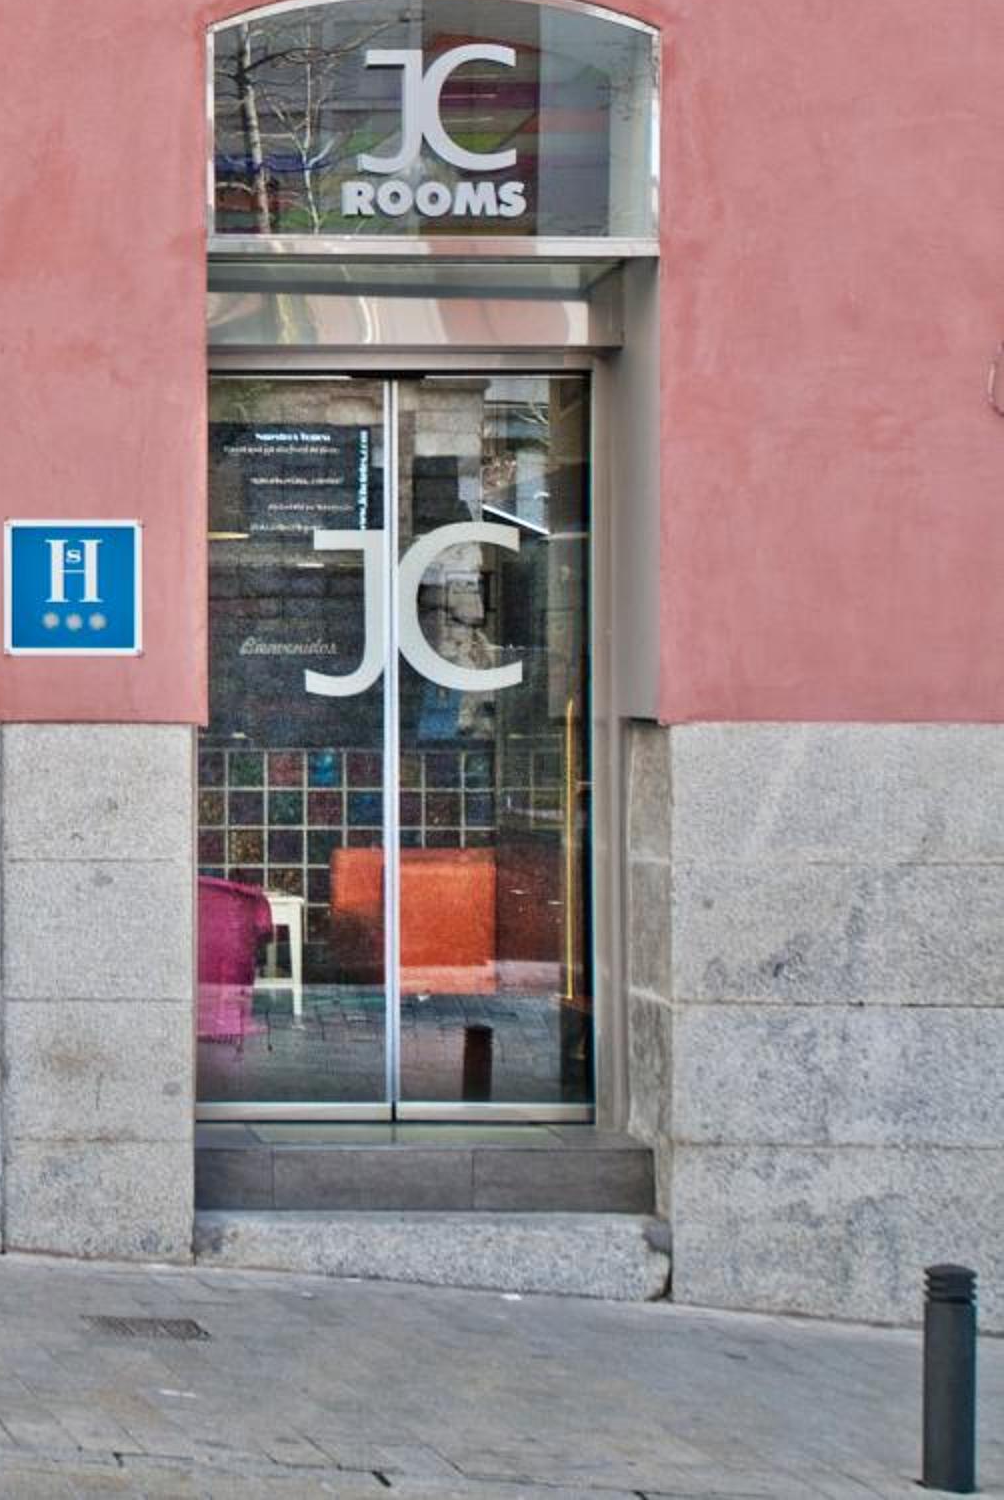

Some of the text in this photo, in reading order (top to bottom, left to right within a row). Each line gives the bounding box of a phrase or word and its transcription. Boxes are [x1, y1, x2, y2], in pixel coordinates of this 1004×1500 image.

[358, 43, 518, 174] JC
[341, 180, 528, 217] ROOMS
[305, 521, 523, 697] JC
